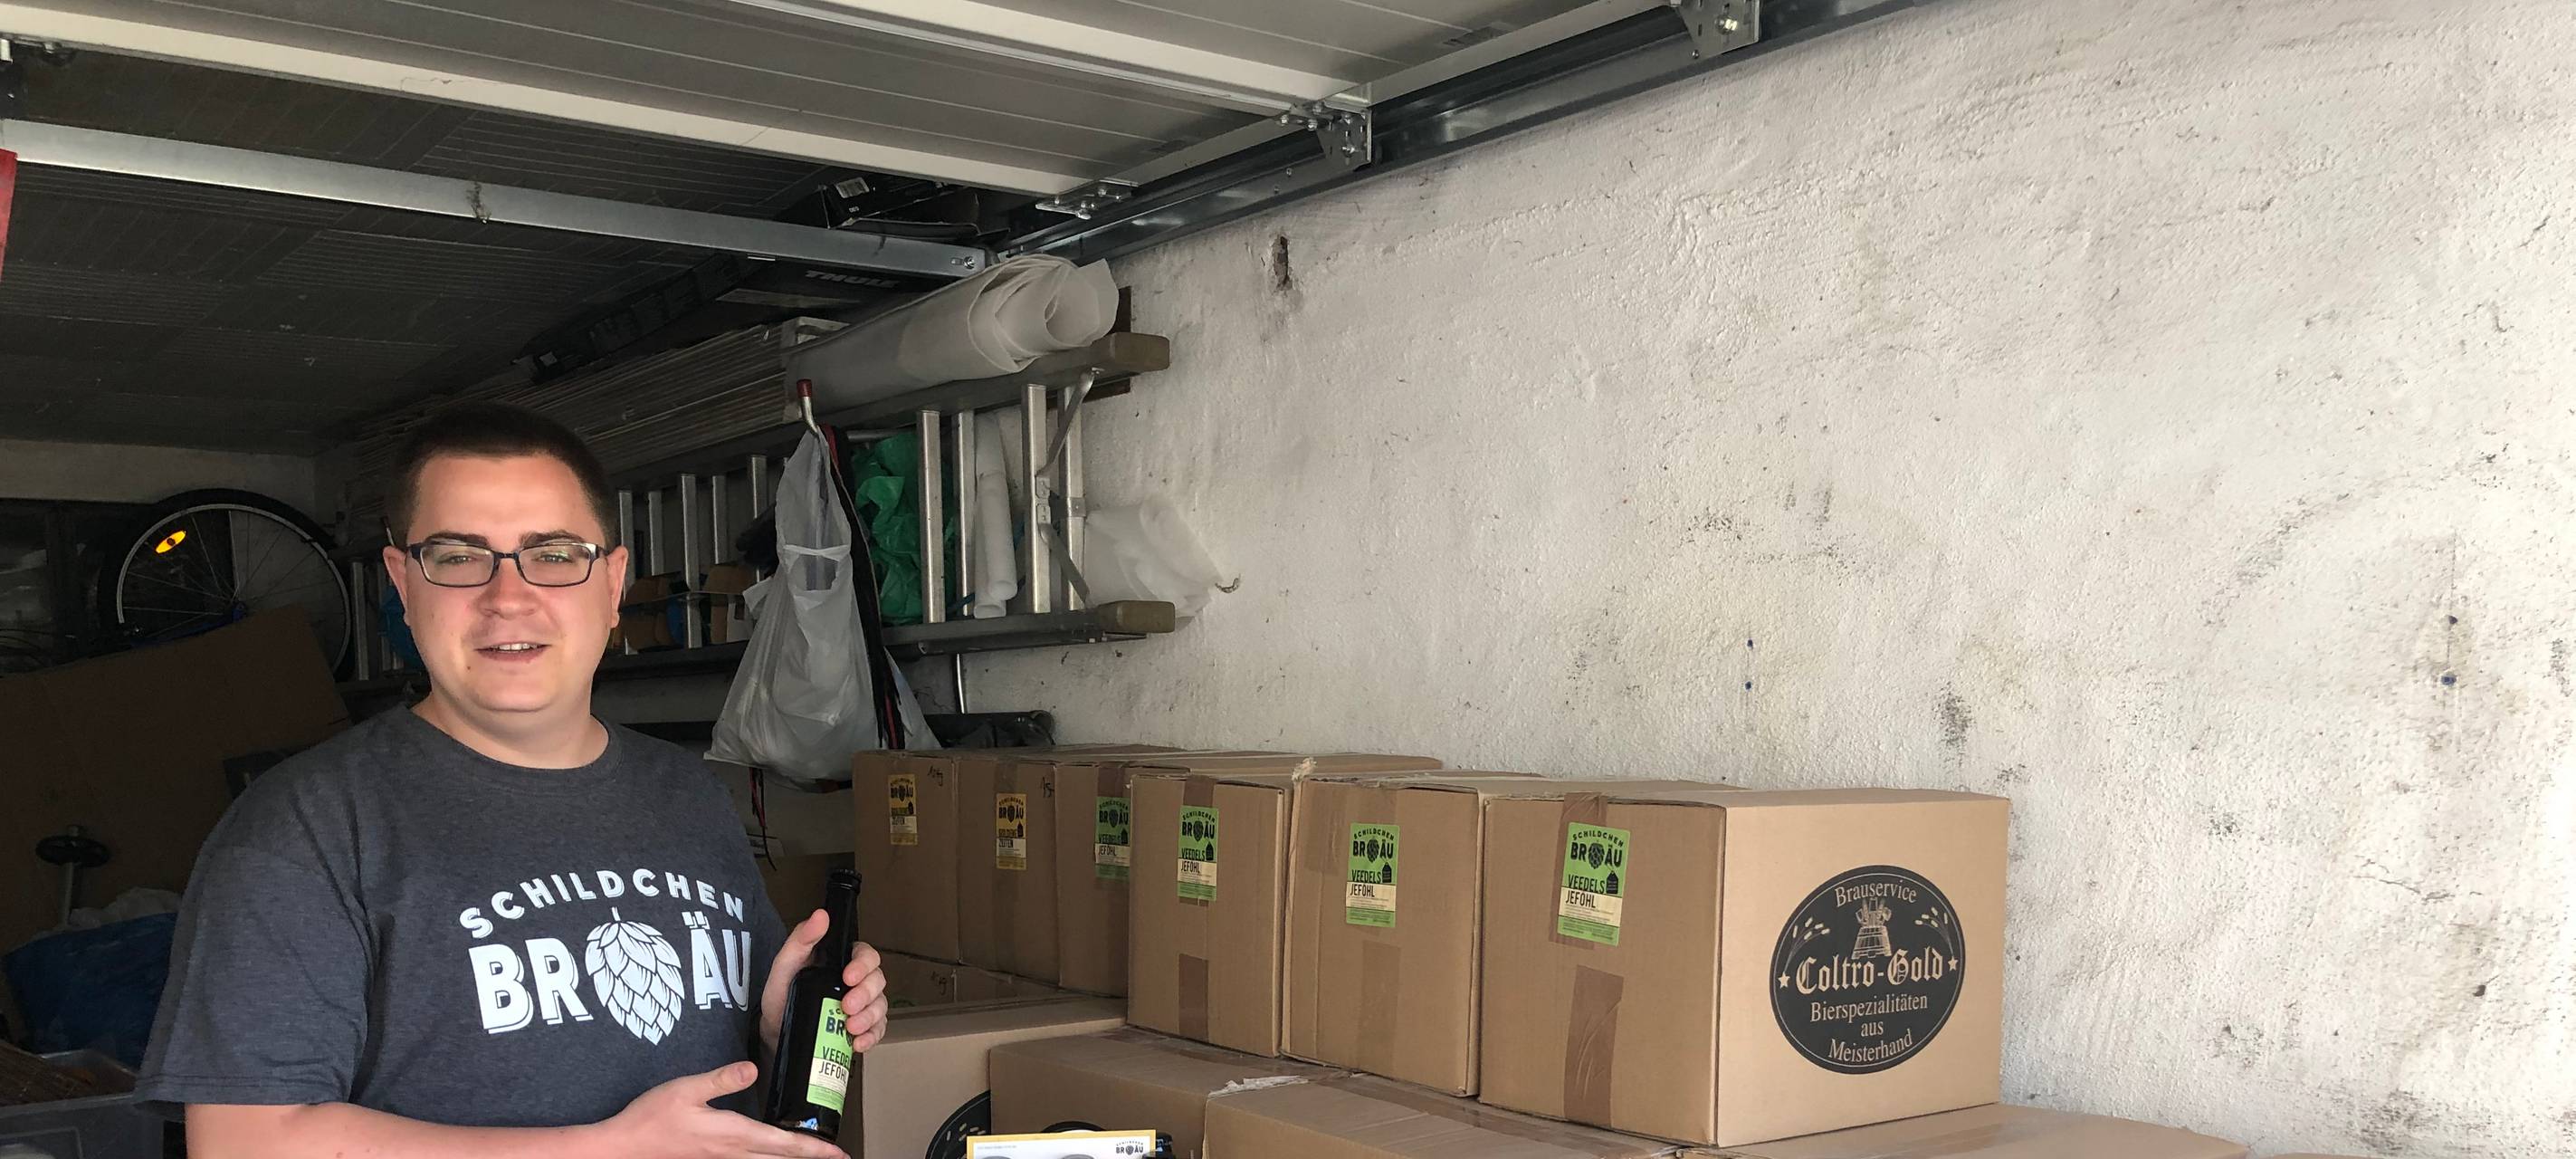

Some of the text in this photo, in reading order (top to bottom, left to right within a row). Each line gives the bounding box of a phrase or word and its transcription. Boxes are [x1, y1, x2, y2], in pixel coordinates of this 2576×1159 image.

[805, 270, 901, 288] THULE
[1353, 828, 1395, 840] SCHILDCHEN
[1572, 830, 1625, 848] SCHILDCHEN
[1181, 848, 1206, 862] VEEDELS
[1351, 869, 1381, 884] VEEDELS
[1568, 874, 1606, 894] VEEDELS
[1835, 879, 1917, 907] Brauservice
[459, 867, 744, 939] SCHILDCHEN
[1796, 946, 1943, 995] Coltro-Gold
[1810, 992, 1929, 1024] Bierspezialitäten
[1861, 1020, 1884, 1038] aus
[1828, 1028, 1913, 1063] Meisterhand
